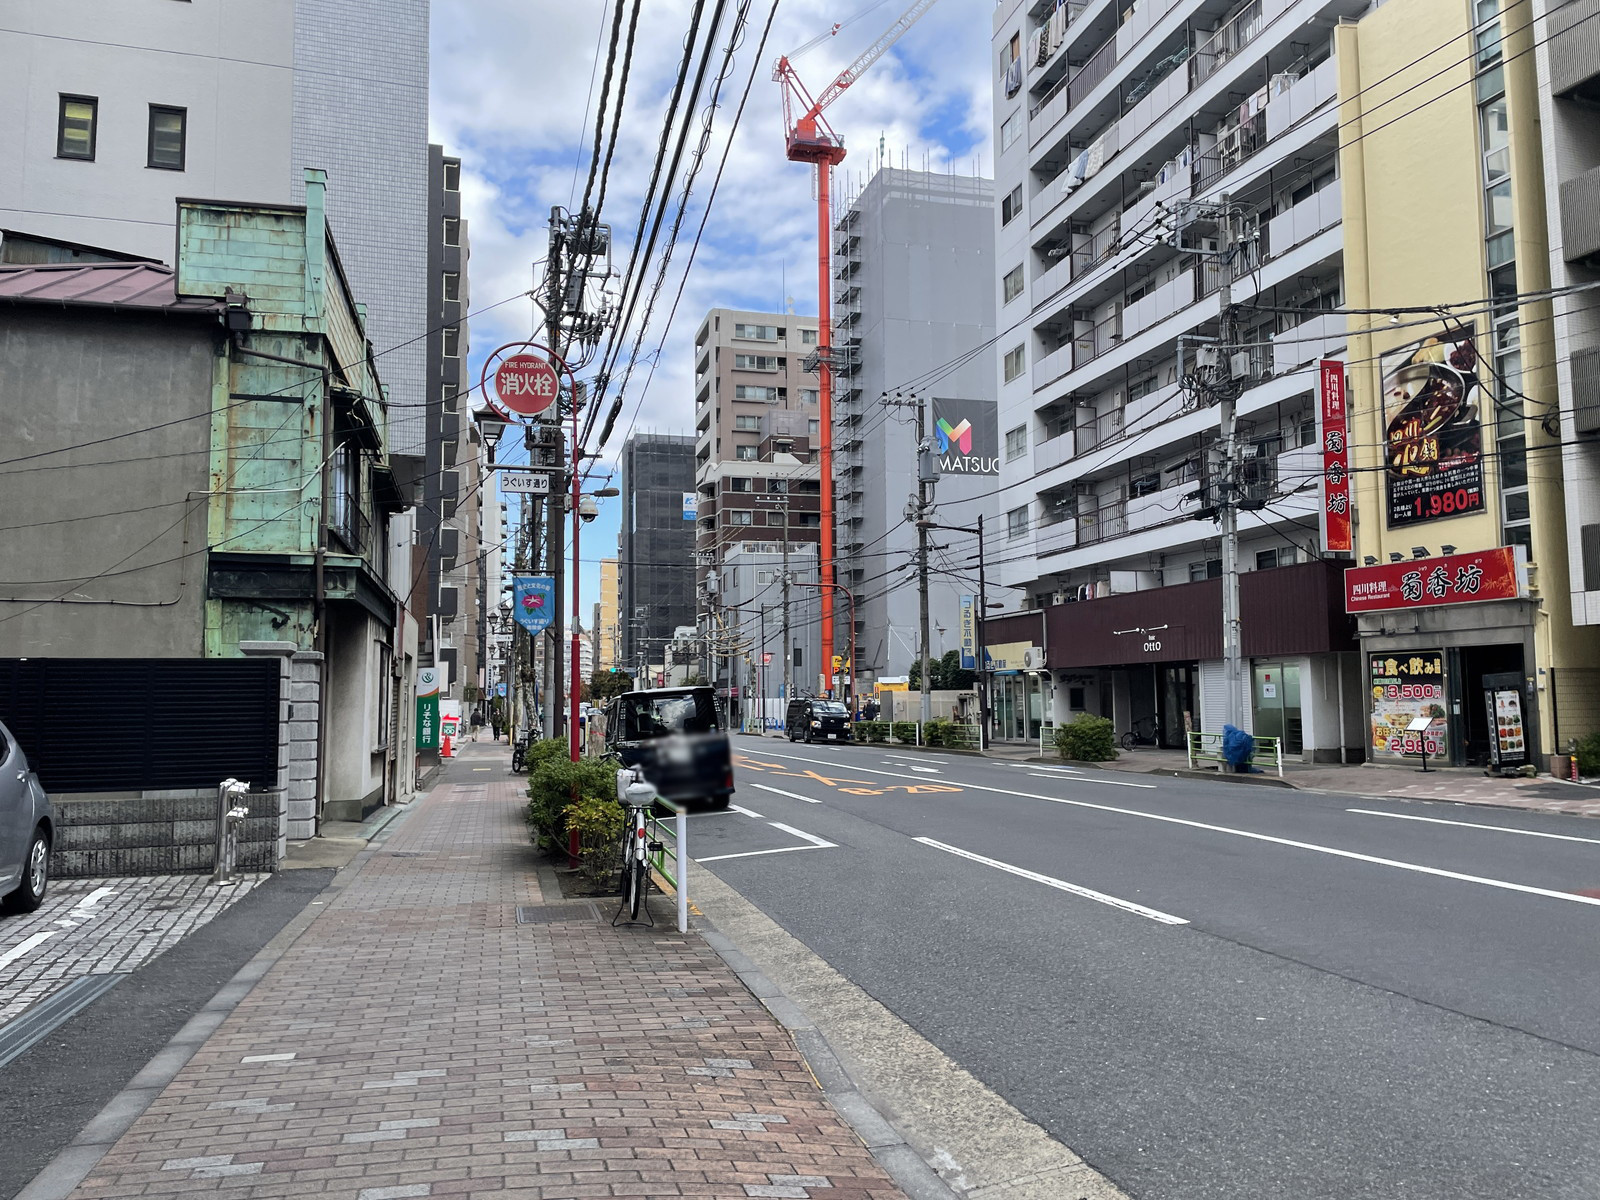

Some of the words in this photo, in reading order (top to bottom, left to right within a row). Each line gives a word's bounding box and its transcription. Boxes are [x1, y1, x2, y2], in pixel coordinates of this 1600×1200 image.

[504, 361, 518, 369] FIRE
[519, 361, 547, 370] HYDRANT
[500, 372, 553, 396] 消火栓
[1330, 374, 1340, 410] 四川料理
[502, 476, 548, 489] うぐいす通り
[1325, 431, 1348, 514] 蜀香坊
[1414, 488, 1480, 518] 1,980円
[1352, 580, 1388, 596] 四川料理
[1368, 592, 1391, 600] Restaurant
[1400, 565, 1483, 602] 蜀香坊
[422, 703, 432, 743] りそな銀行
